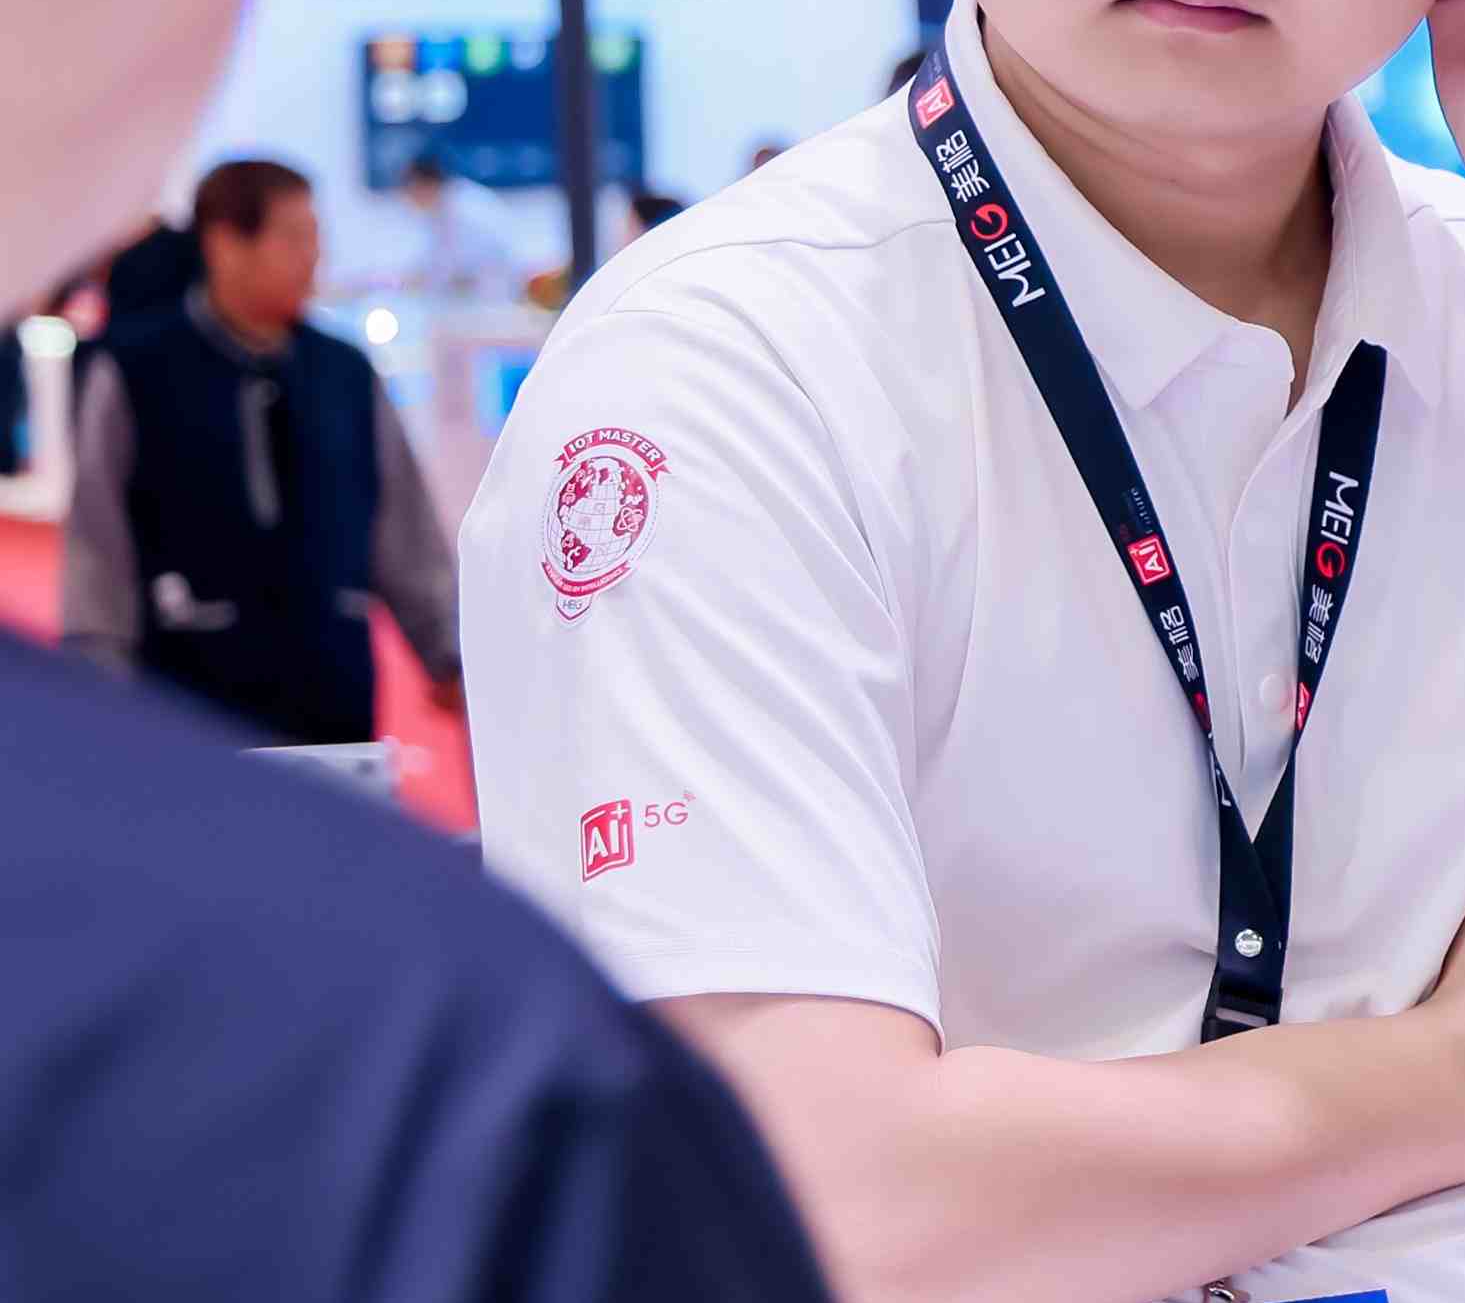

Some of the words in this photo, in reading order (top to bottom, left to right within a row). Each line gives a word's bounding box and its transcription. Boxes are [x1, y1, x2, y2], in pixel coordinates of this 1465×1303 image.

[936, 129, 990, 202] 美格
[971, 203, 1046, 307] MEIG
[599, 429, 662, 462] MASTER
[1315, 471, 1358, 579] MEIG
[1305, 584, 1333, 664] 美格
